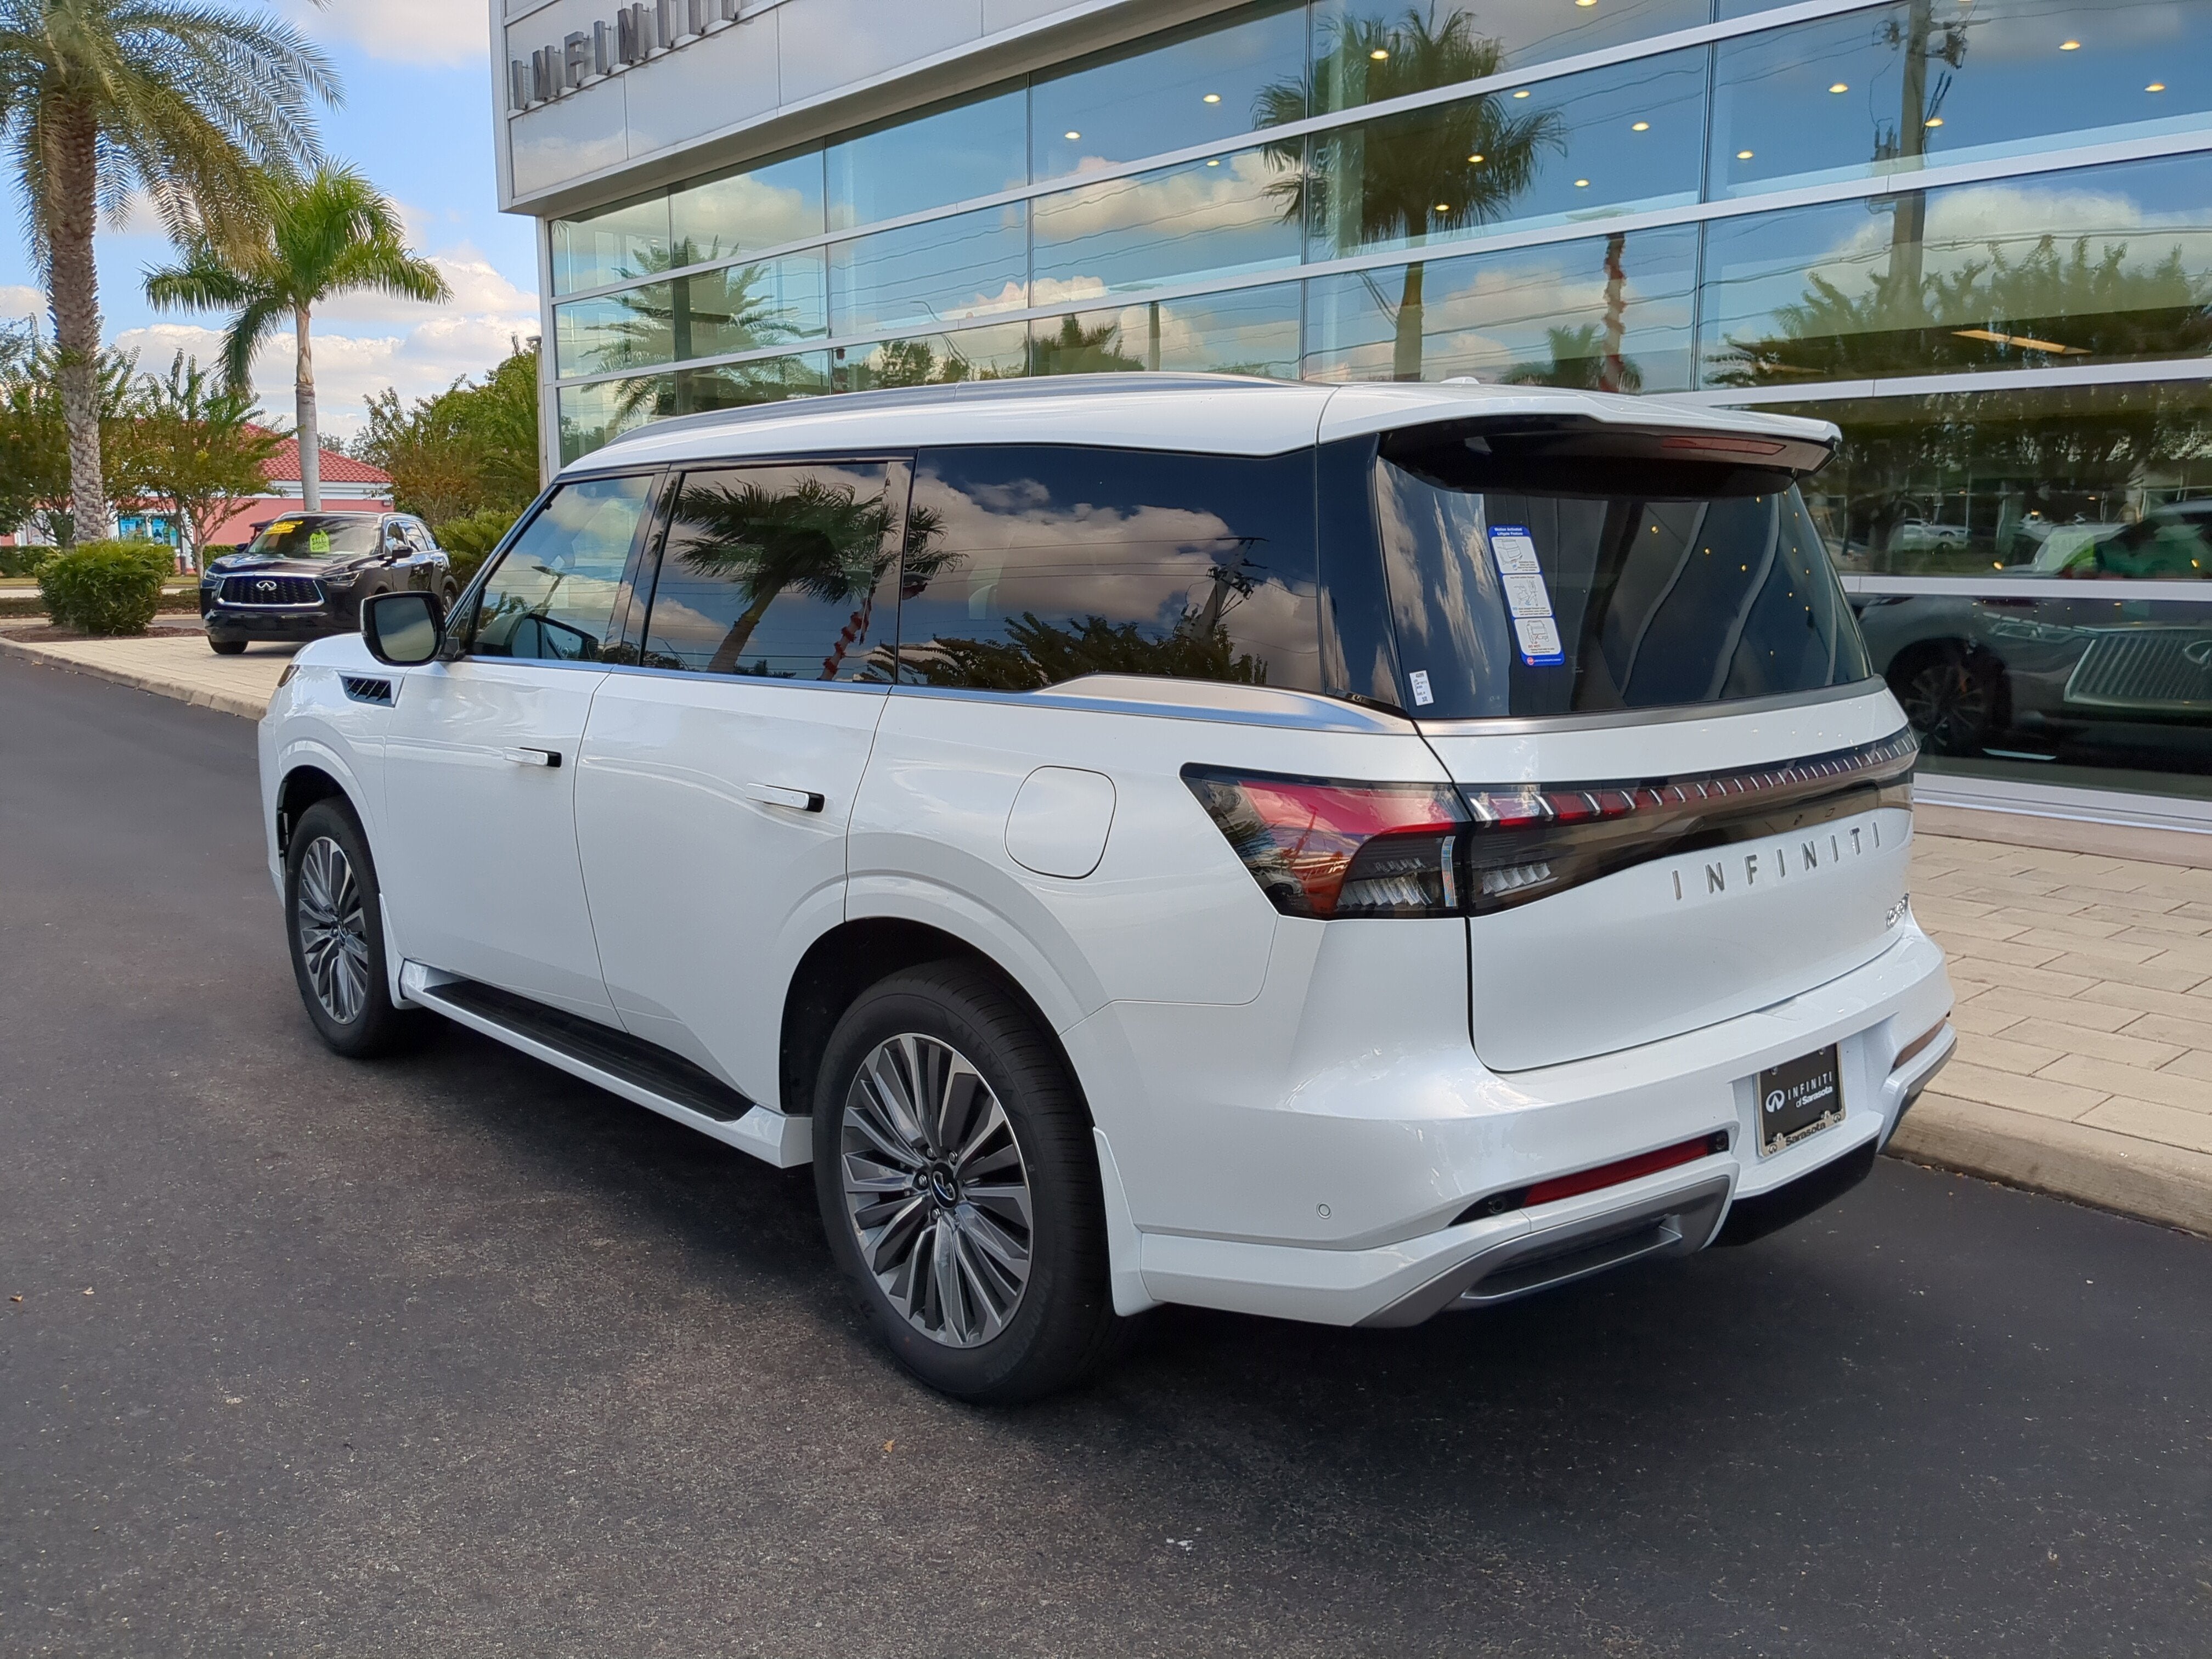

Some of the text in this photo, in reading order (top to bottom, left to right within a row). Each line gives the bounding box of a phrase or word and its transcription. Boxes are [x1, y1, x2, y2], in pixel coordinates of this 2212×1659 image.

[1672, 822, 1880, 900] INFINITI
[1788, 1071, 1832, 1100] INFINITI
[1803, 1086, 1832, 1104] Sarasota
[1786, 1122, 1825, 1146] Sarasota
